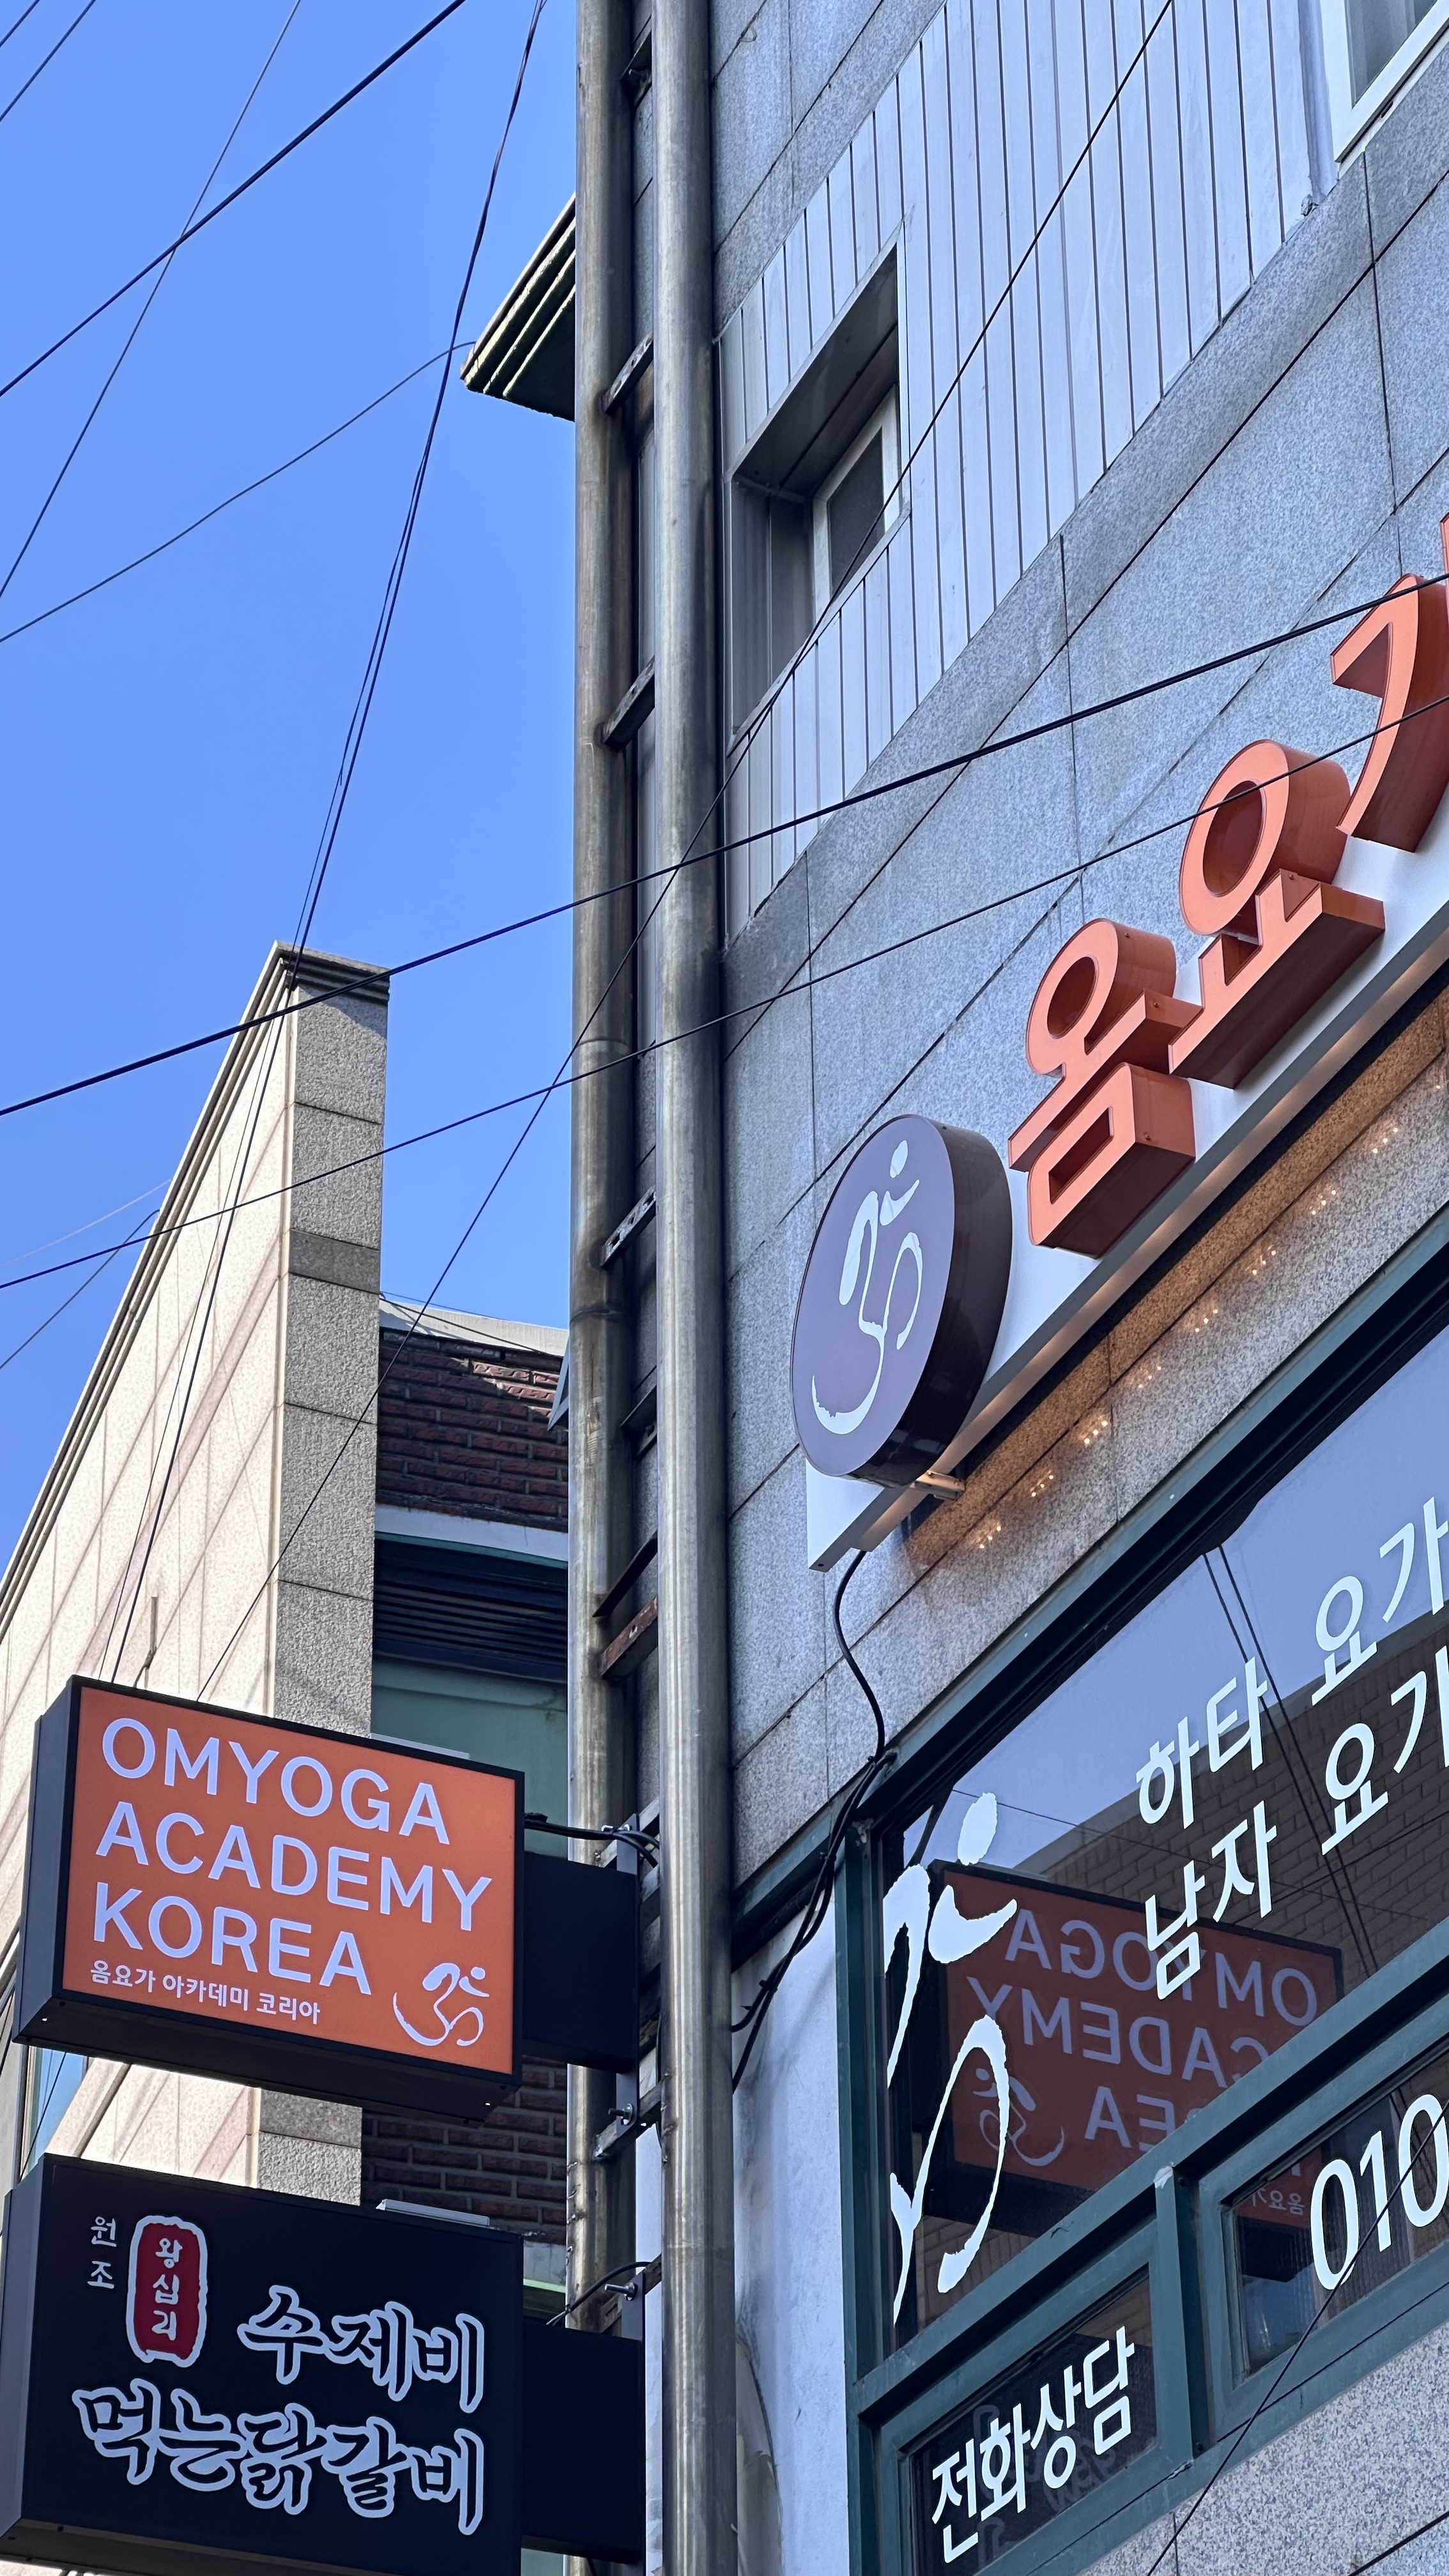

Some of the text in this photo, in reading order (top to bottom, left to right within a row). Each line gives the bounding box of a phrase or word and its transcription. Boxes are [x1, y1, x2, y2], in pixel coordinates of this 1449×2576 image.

[1008, 511, 1449, 1257] 옴요
[1136, 1496, 1449, 1828] 하타 요가
[102, 1717, 450, 1846] OMYOGA
[95, 1800, 492, 1932] ACADEMY
[1144, 1800, 1276, 2000] 남자
[91, 1959, 321, 2025] 옴요가 아카데미 코리아
[93, 1881, 372, 1996] KOREA
[87, 2216, 117, 2289] 원조
[1310, 2094, 1449, 2290] 010
[151, 2237, 183, 2341] 왕십리
[237, 2285, 485, 2414] 수제비
[931, 2326, 1135, 2563] 전화상담
